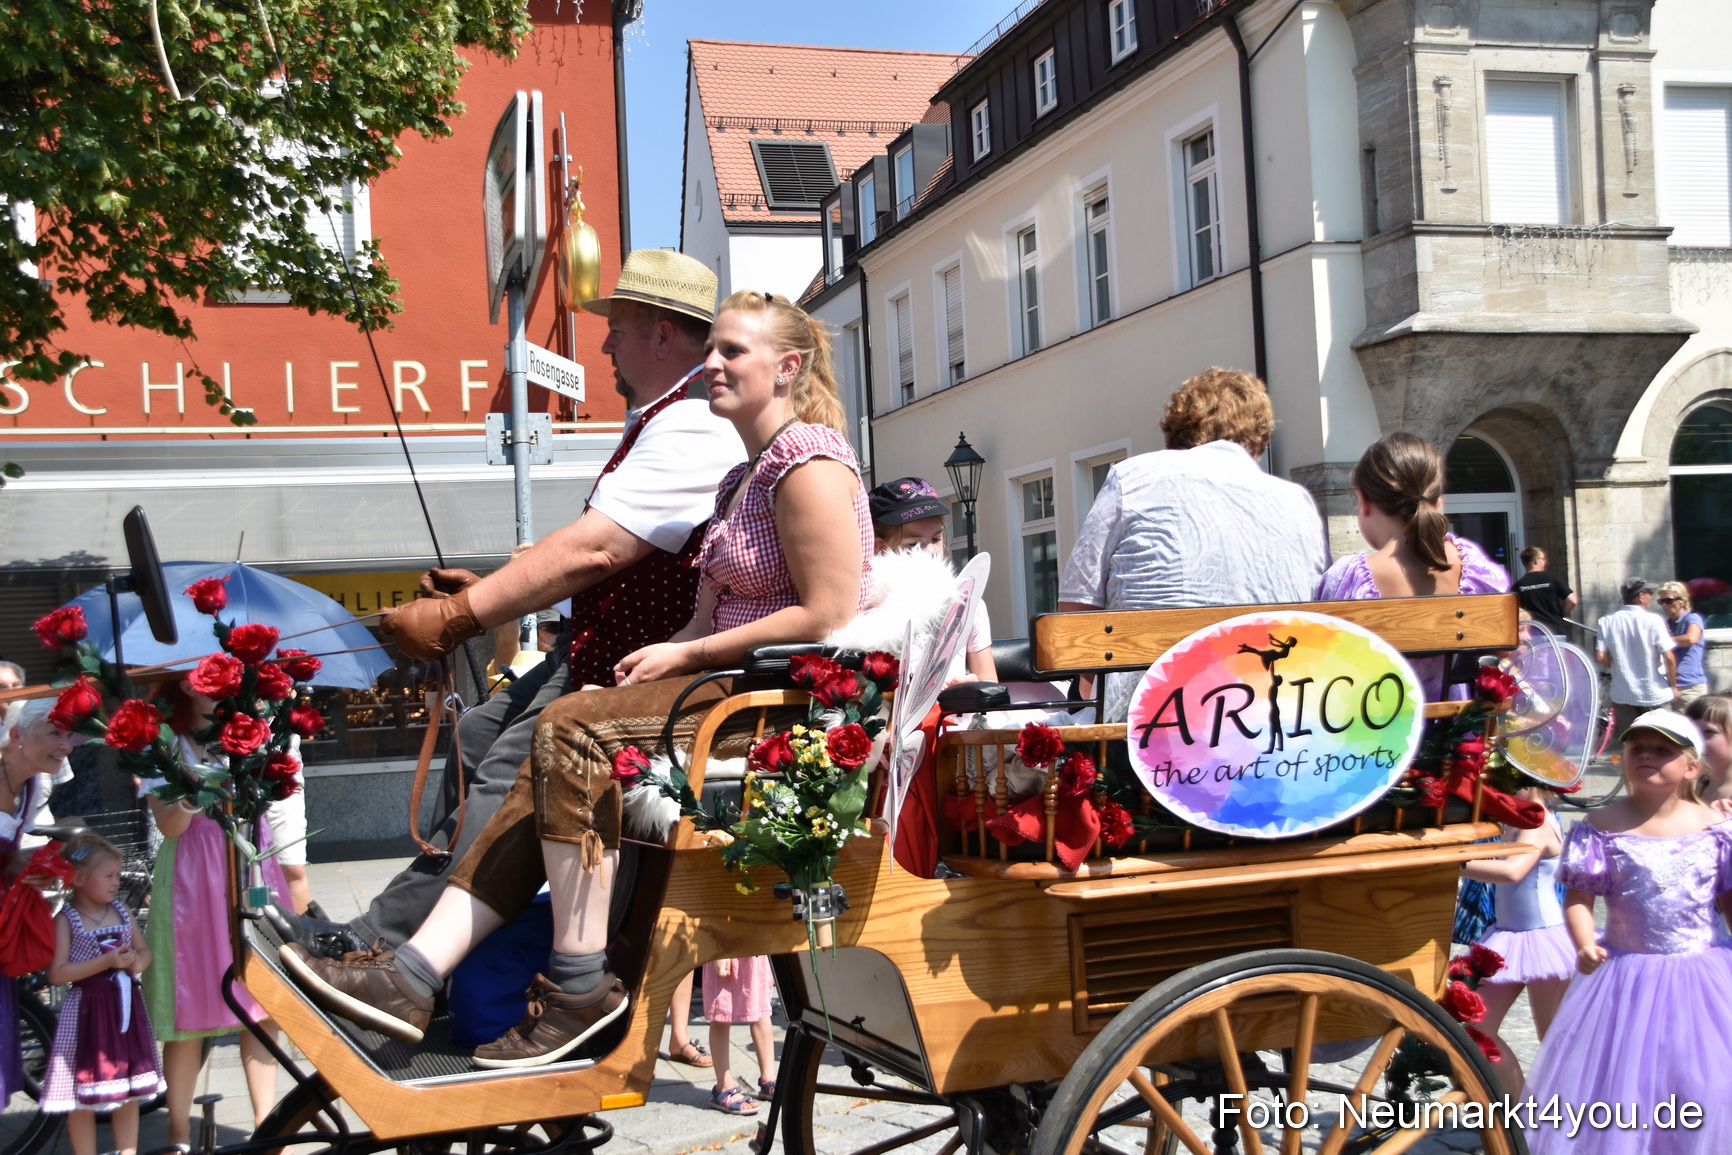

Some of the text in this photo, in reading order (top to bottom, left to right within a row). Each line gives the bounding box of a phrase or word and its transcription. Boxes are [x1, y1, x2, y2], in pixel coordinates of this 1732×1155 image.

[0, 360, 489, 415] SCHLIERF
[529, 350, 580, 391] Rosengasse
[1151, 745, 1401, 788] the art of sports
